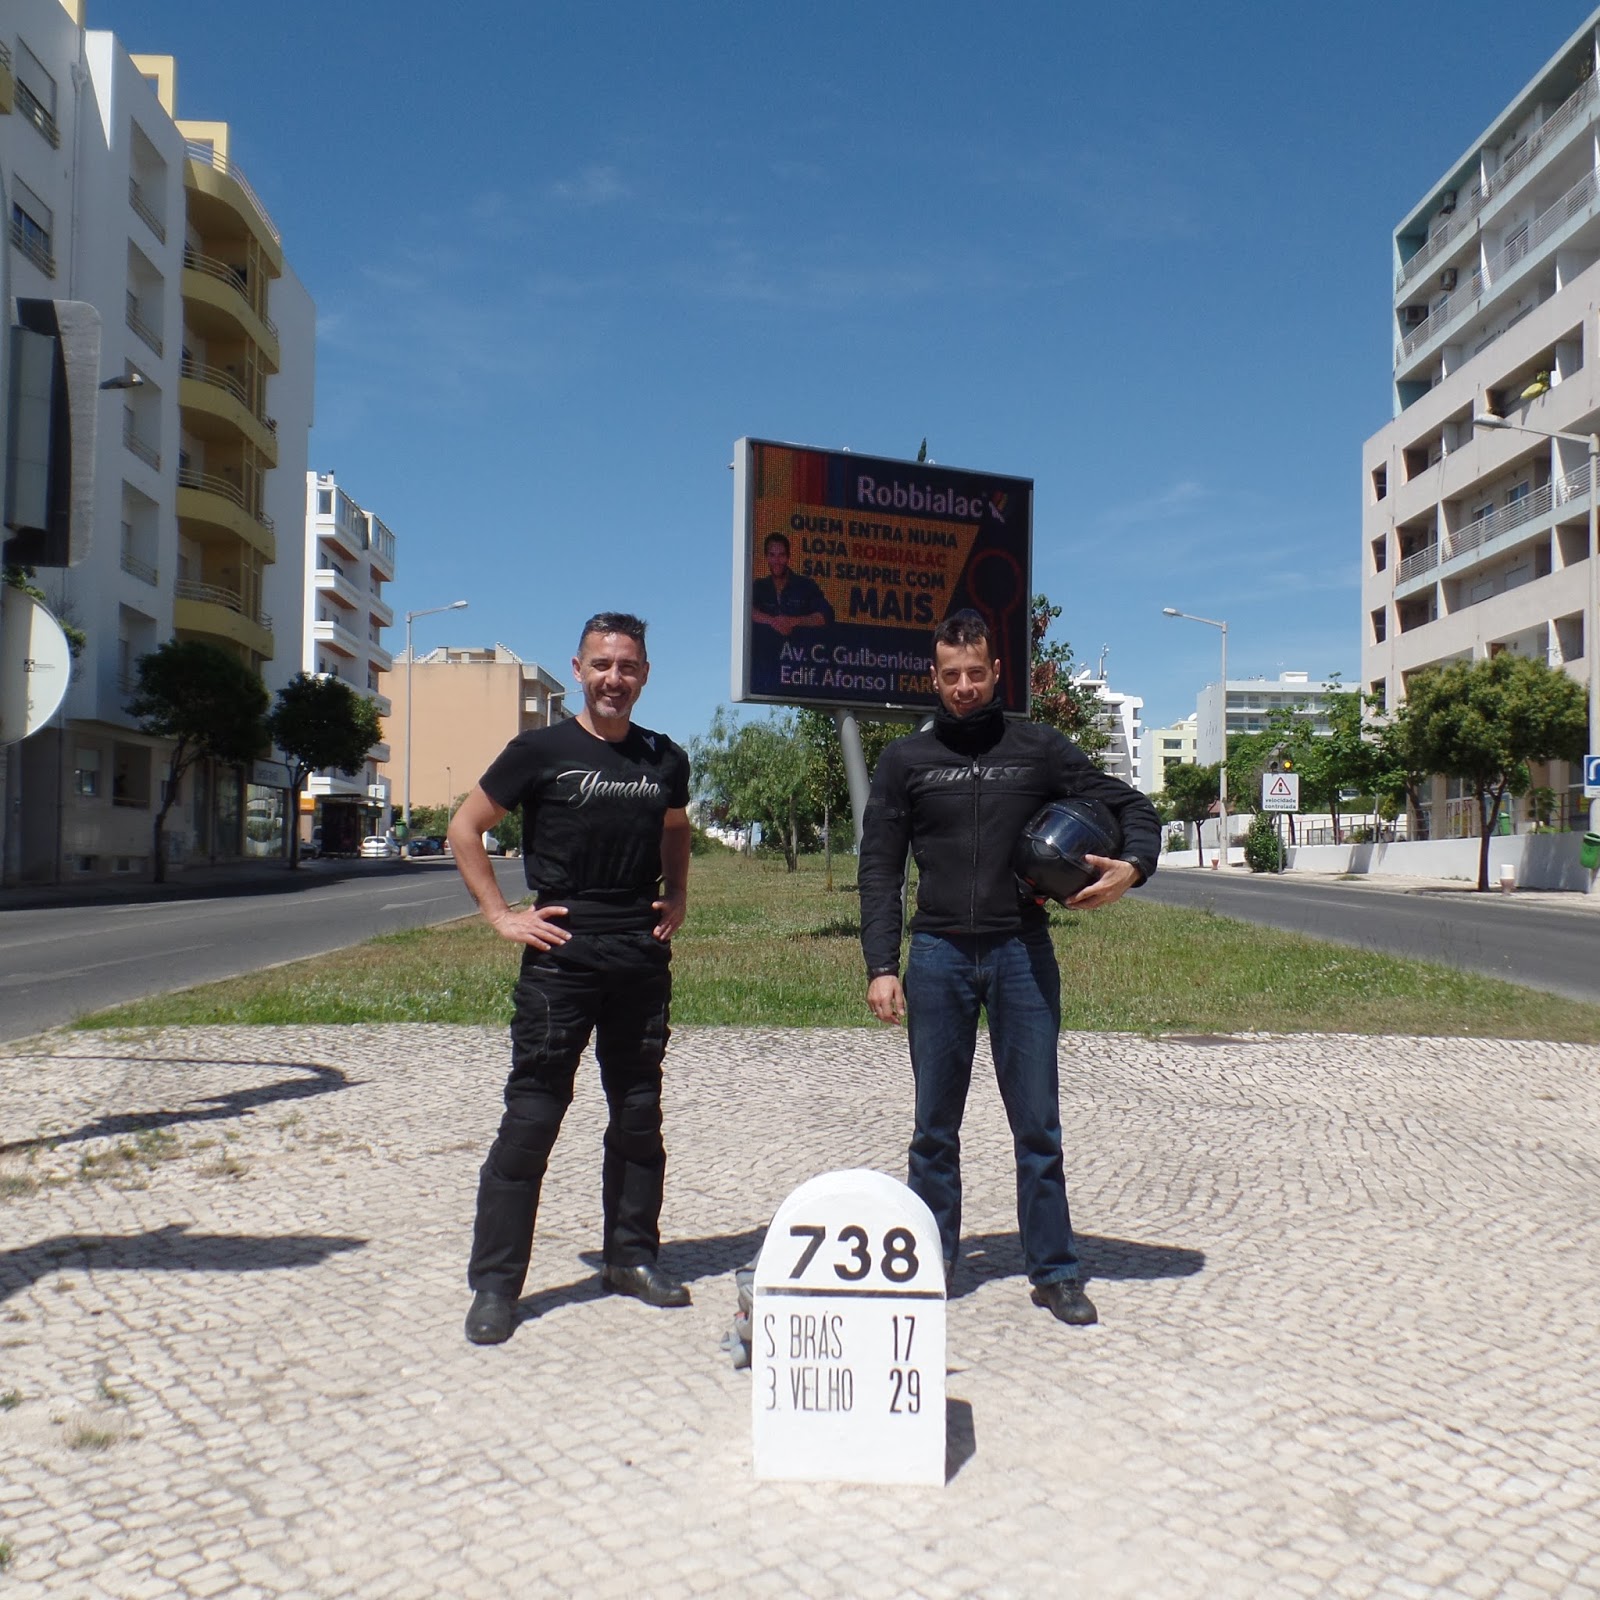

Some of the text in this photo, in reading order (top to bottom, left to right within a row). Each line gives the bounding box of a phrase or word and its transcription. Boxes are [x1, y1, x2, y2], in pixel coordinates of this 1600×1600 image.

[858, 476, 983, 517] Robbialac
[790, 514, 957, 549] QUEM ENTRA NUMA
[802, 538, 947, 568] LOJA ROBBIALAC
[803, 560, 945, 590] SAI SEMPRE COM
[780, 641, 934, 671] Av. C. Gulbenkian
[781, 665, 818, 686] Edif.
[822, 669, 886, 690] Afonso
[899, 675, 938, 694] FAR
[556, 770, 660, 809] Yamaha
[788, 1225, 919, 1283] 738
[789, 1310, 843, 1360] BRÁS
[892, 1315, 916, 1361] 17
[789, 1366, 854, 1412] VELHO
[889, 1368, 921, 1414] 29
